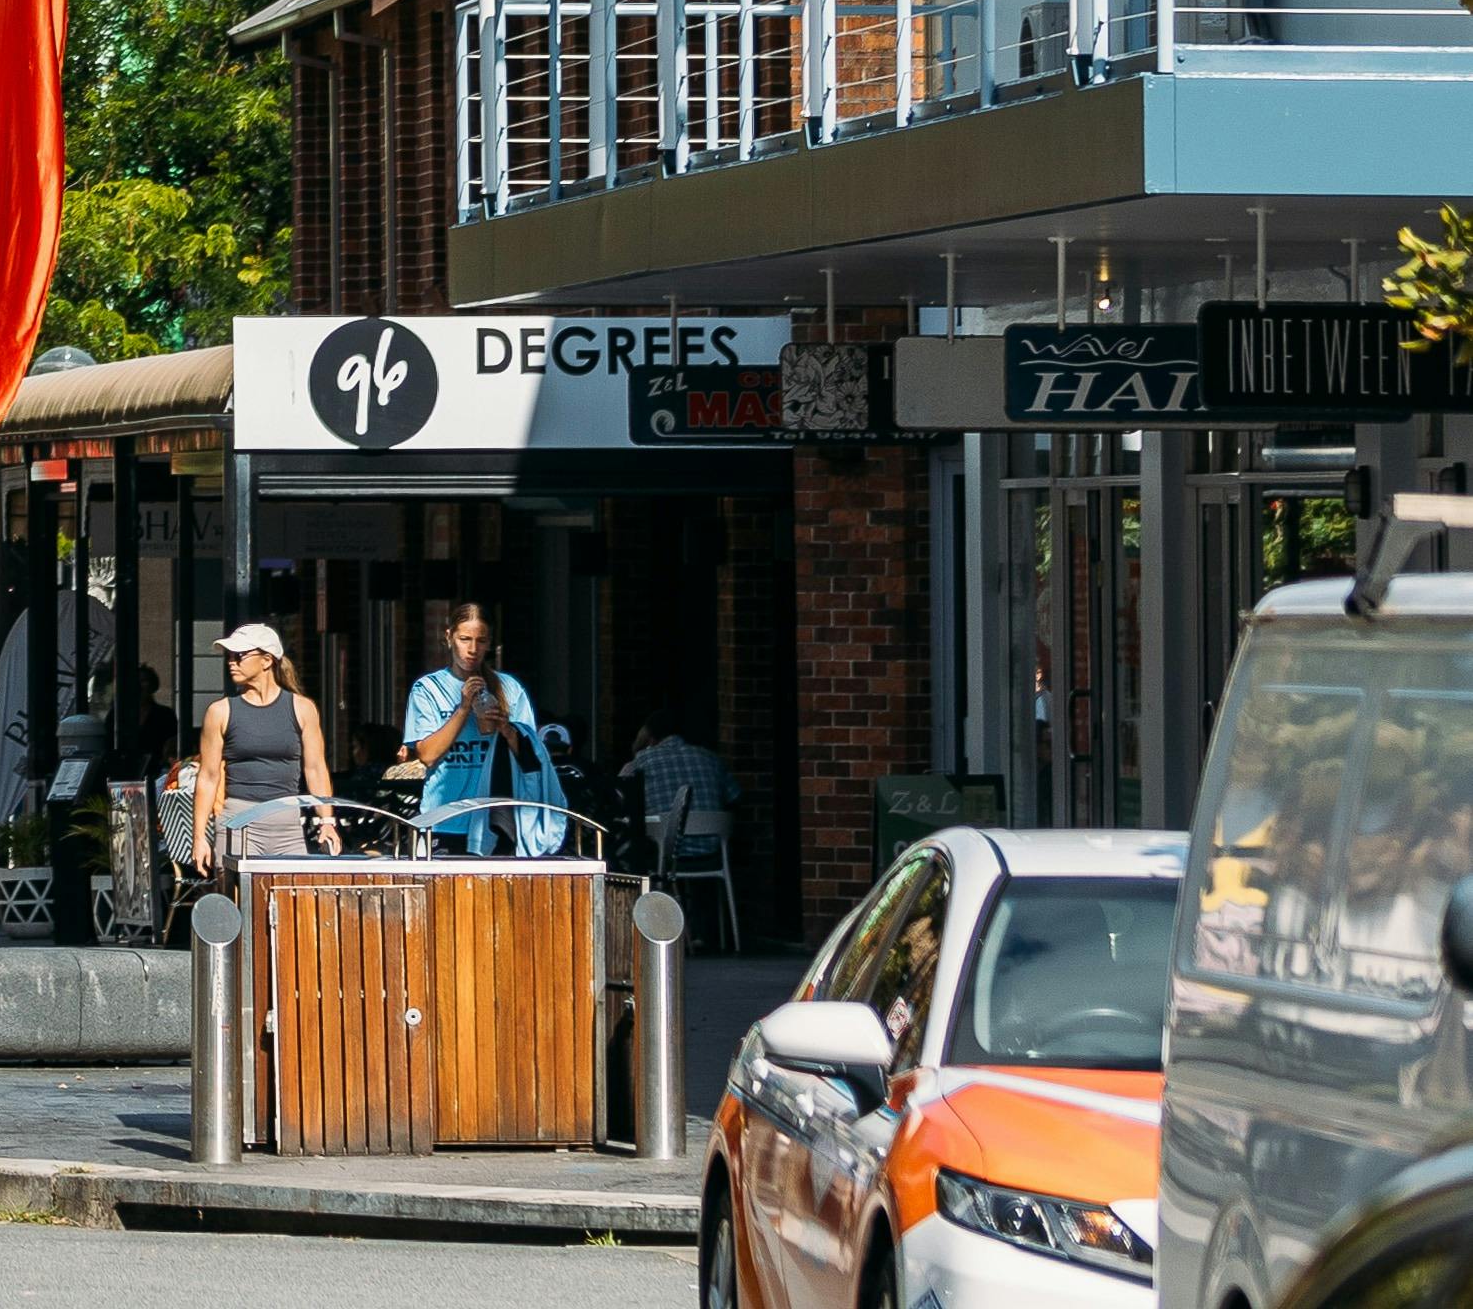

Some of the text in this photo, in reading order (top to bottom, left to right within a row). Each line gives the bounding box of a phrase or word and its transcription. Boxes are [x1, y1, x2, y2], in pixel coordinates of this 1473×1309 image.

[337, 325, 739, 436] 96 DEGREES
[1023, 371, 1207, 413] HAI
[1227, 318, 1411, 396] INBETWEEN
